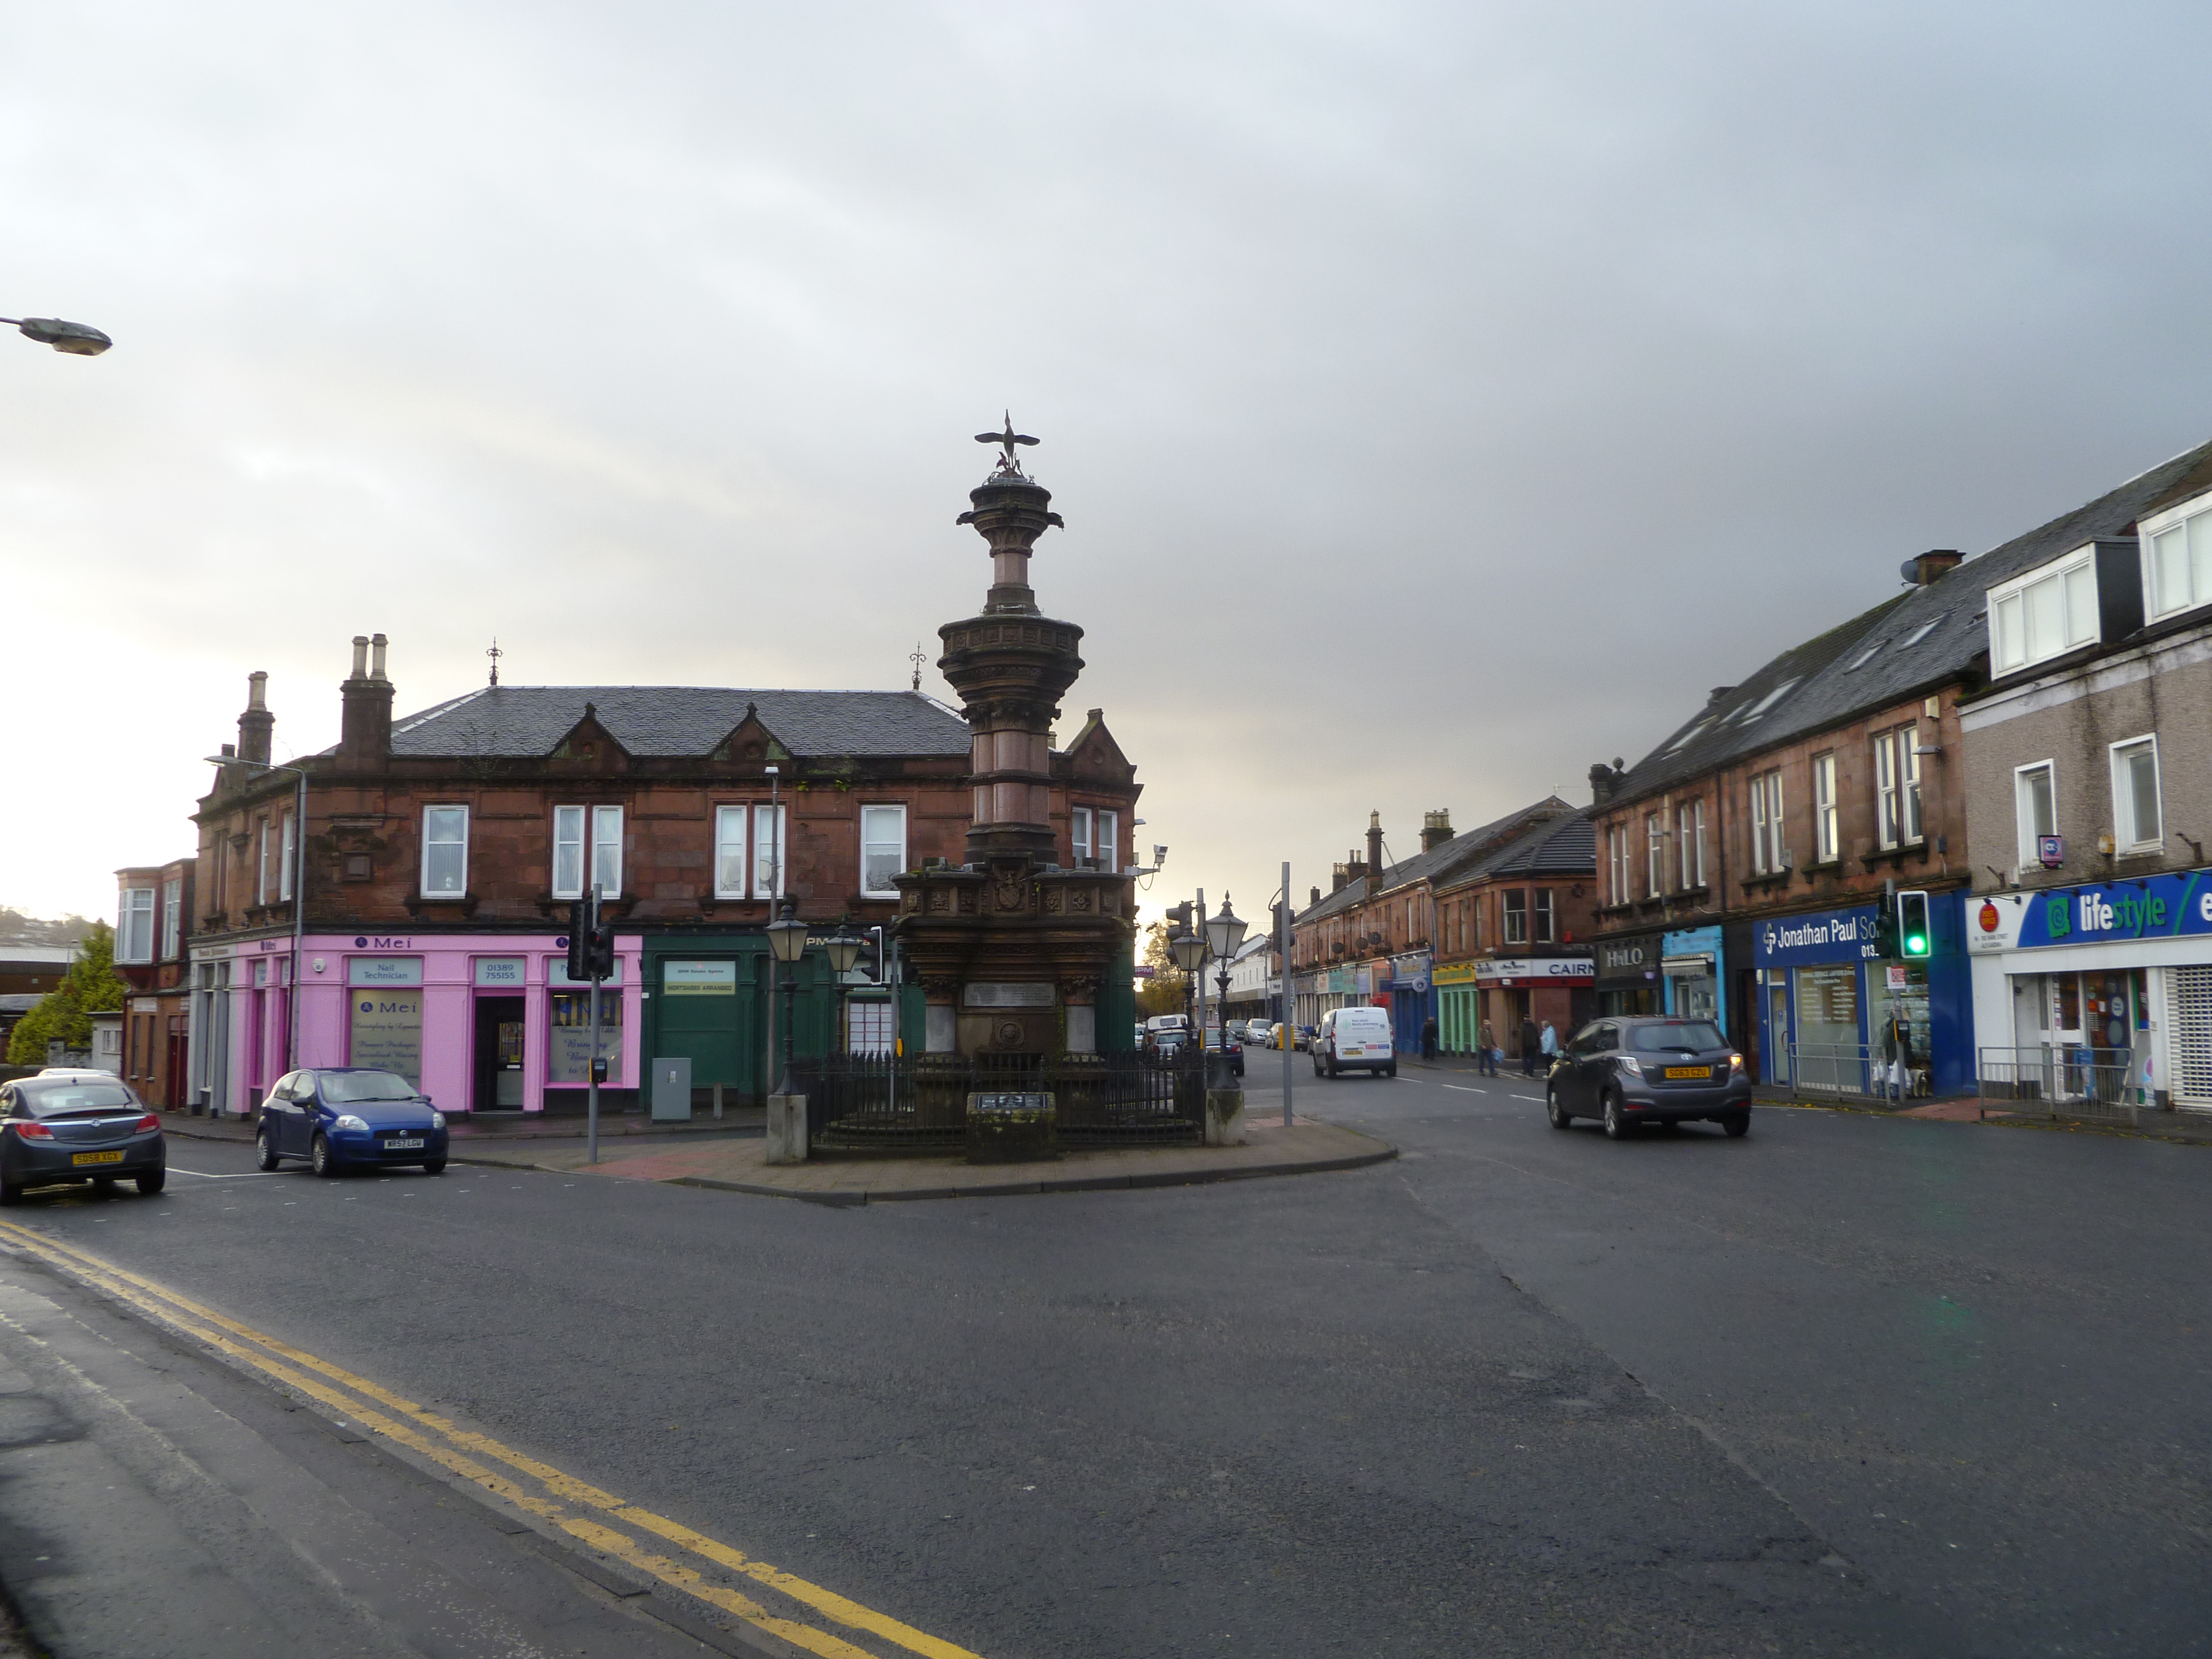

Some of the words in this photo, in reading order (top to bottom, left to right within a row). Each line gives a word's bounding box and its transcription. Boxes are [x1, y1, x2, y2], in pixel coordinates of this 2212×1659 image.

[2080, 889, 2166, 938] lifestyle
[1778, 923, 1828, 948] Jonathan
[1831, 917, 1857, 942] Paul
[374, 938, 411, 948] Mei
[1607, 947, 1644, 967] HALO
[379, 1002, 417, 1013] Mei
